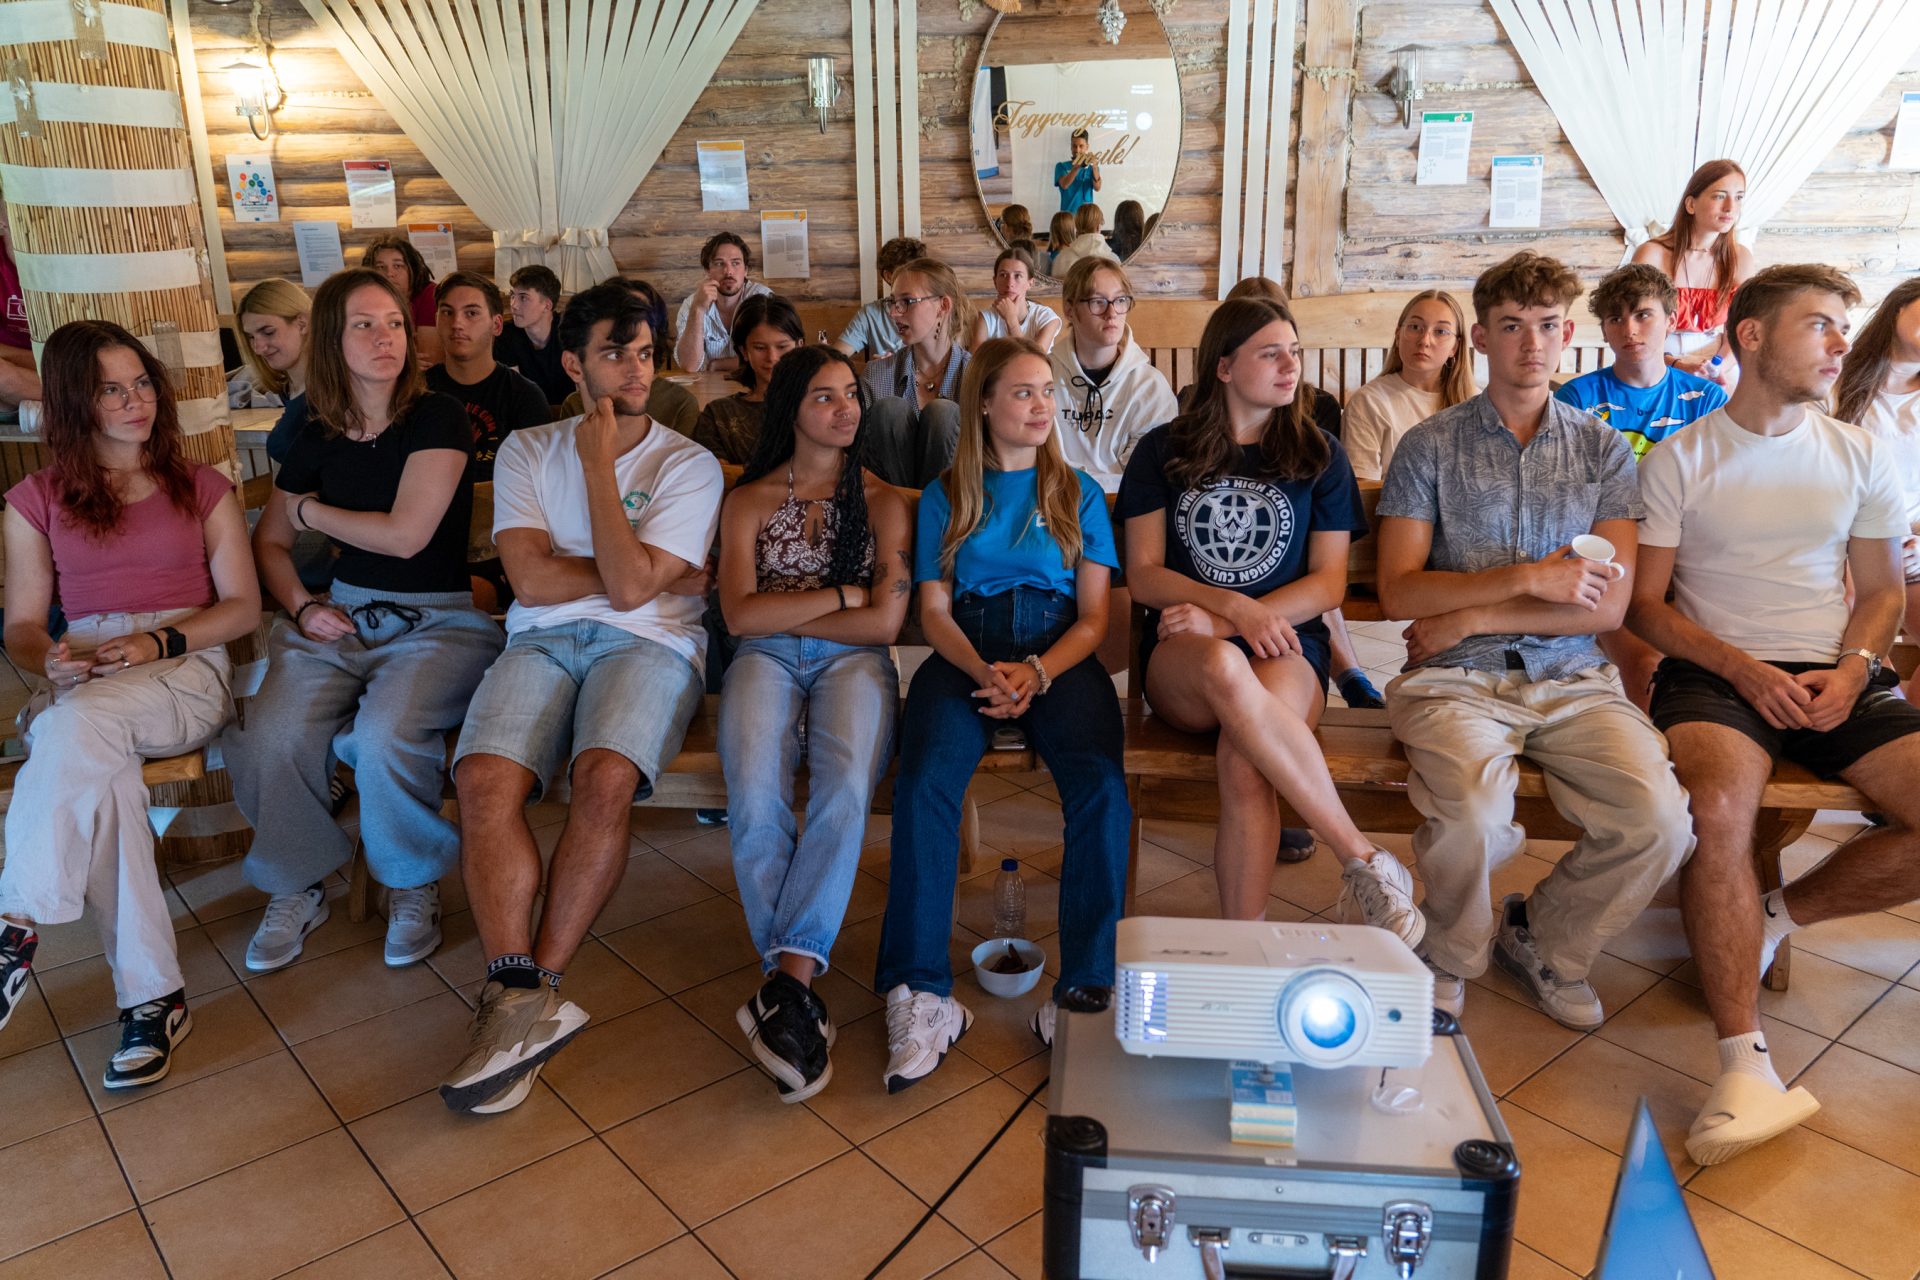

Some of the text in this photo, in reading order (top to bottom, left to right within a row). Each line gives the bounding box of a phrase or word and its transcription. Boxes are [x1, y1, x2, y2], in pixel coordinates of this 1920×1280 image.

[992, 100, 1109, 138] Tegyvuoja
[1233, 479, 1267, 493] HIGH
[1265, 488, 1291, 537] SCHOOL
[1239, 537, 1286, 583] FOREIGN
